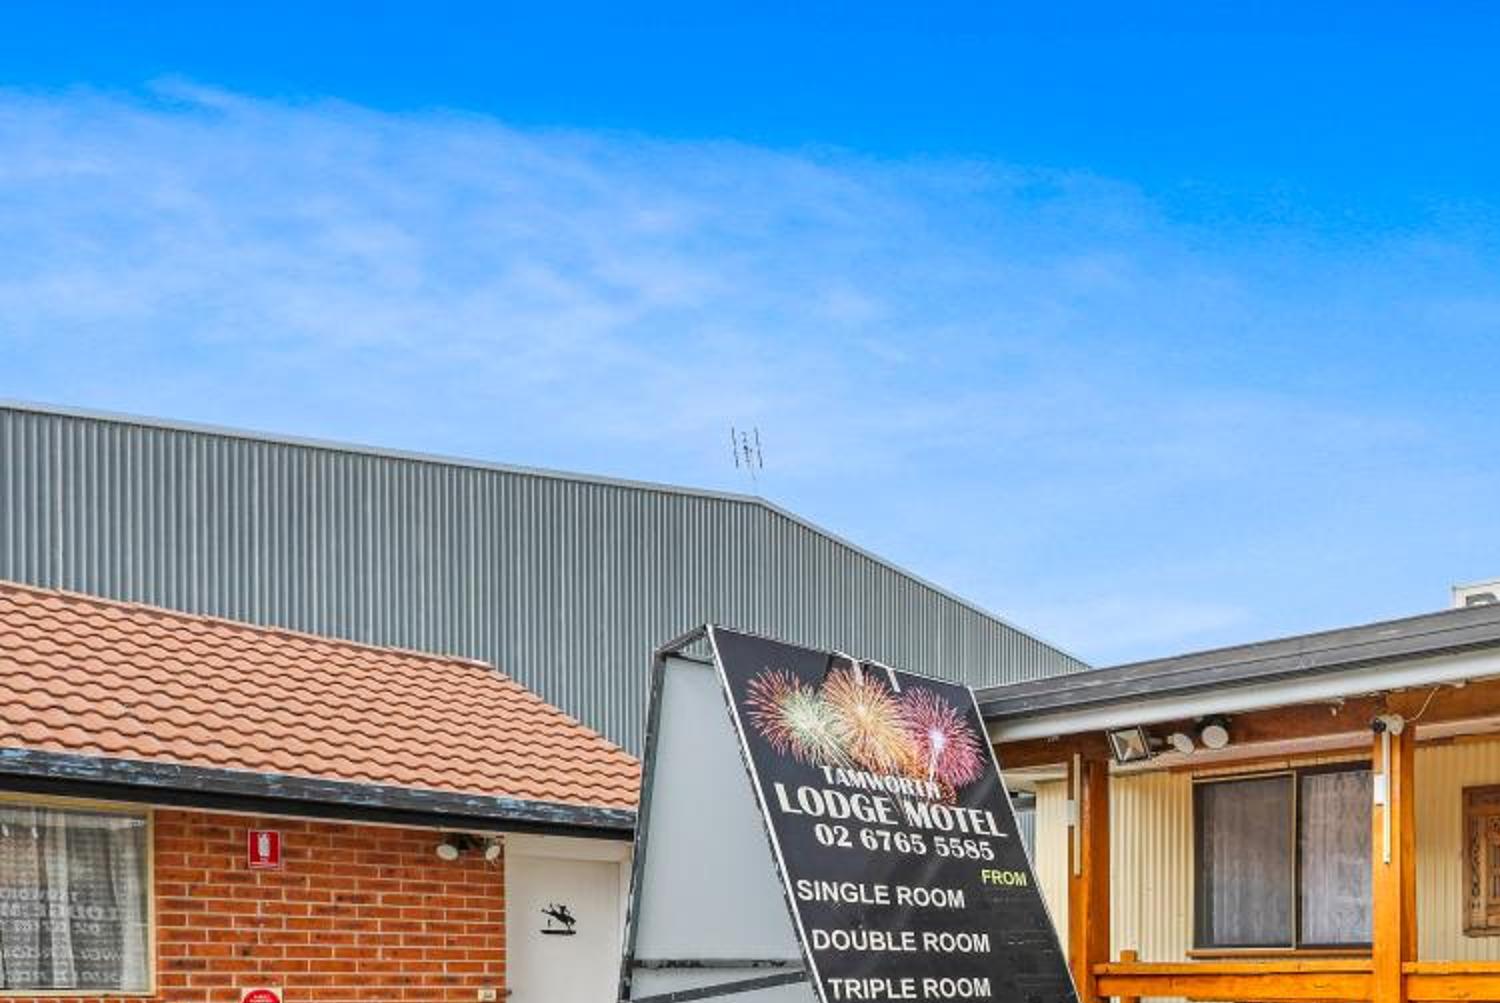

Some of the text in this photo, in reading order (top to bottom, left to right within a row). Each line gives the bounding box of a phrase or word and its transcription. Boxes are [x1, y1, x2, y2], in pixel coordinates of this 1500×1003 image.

[820, 765, 942, 799] TAMWORTH
[774, 783, 1008, 837] LODGE MOTEL
[815, 823, 994, 861] 02 6765 5585
[981, 869, 1027, 887] FROM
[797, 879, 965, 909] SINGLE ROOM
[812, 929, 990, 953] DOUBLE ROOM
[828, 978, 992, 1000] TRIPLE ROOM
